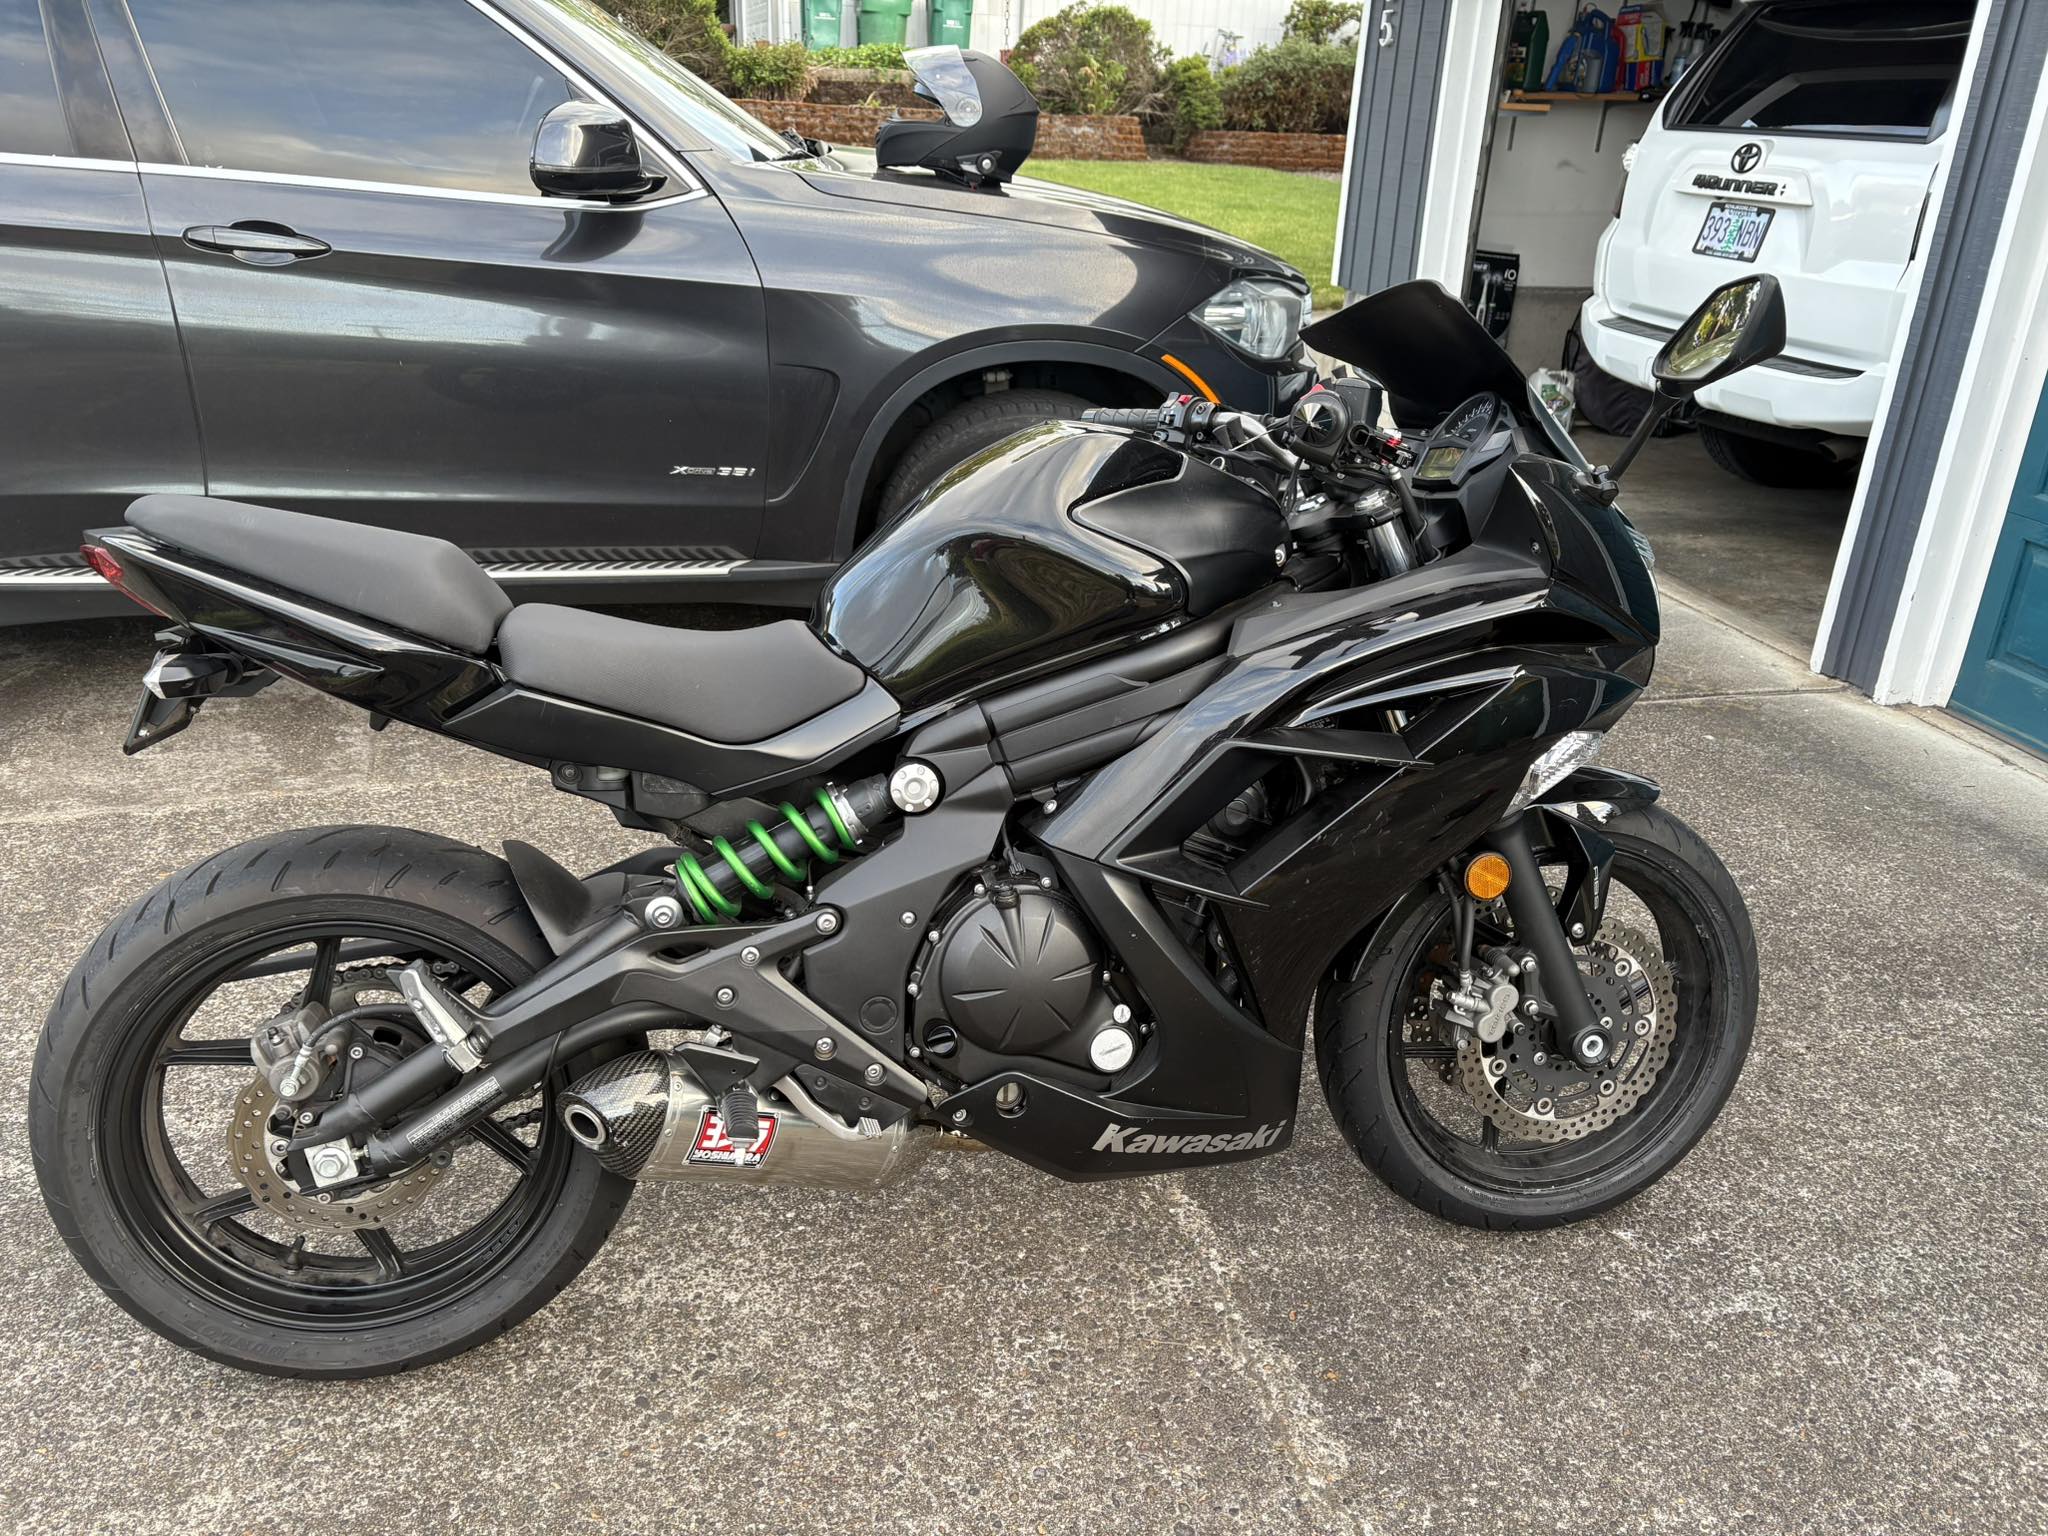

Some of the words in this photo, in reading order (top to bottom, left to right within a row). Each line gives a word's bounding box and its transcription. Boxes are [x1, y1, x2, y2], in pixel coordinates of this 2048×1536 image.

[1379, 9, 1394, 47] 5
[1702, 215, 1731, 244] 393
[1732, 218, 1766, 249] NBN
[1092, 1119, 1287, 1154] Kawasaki
